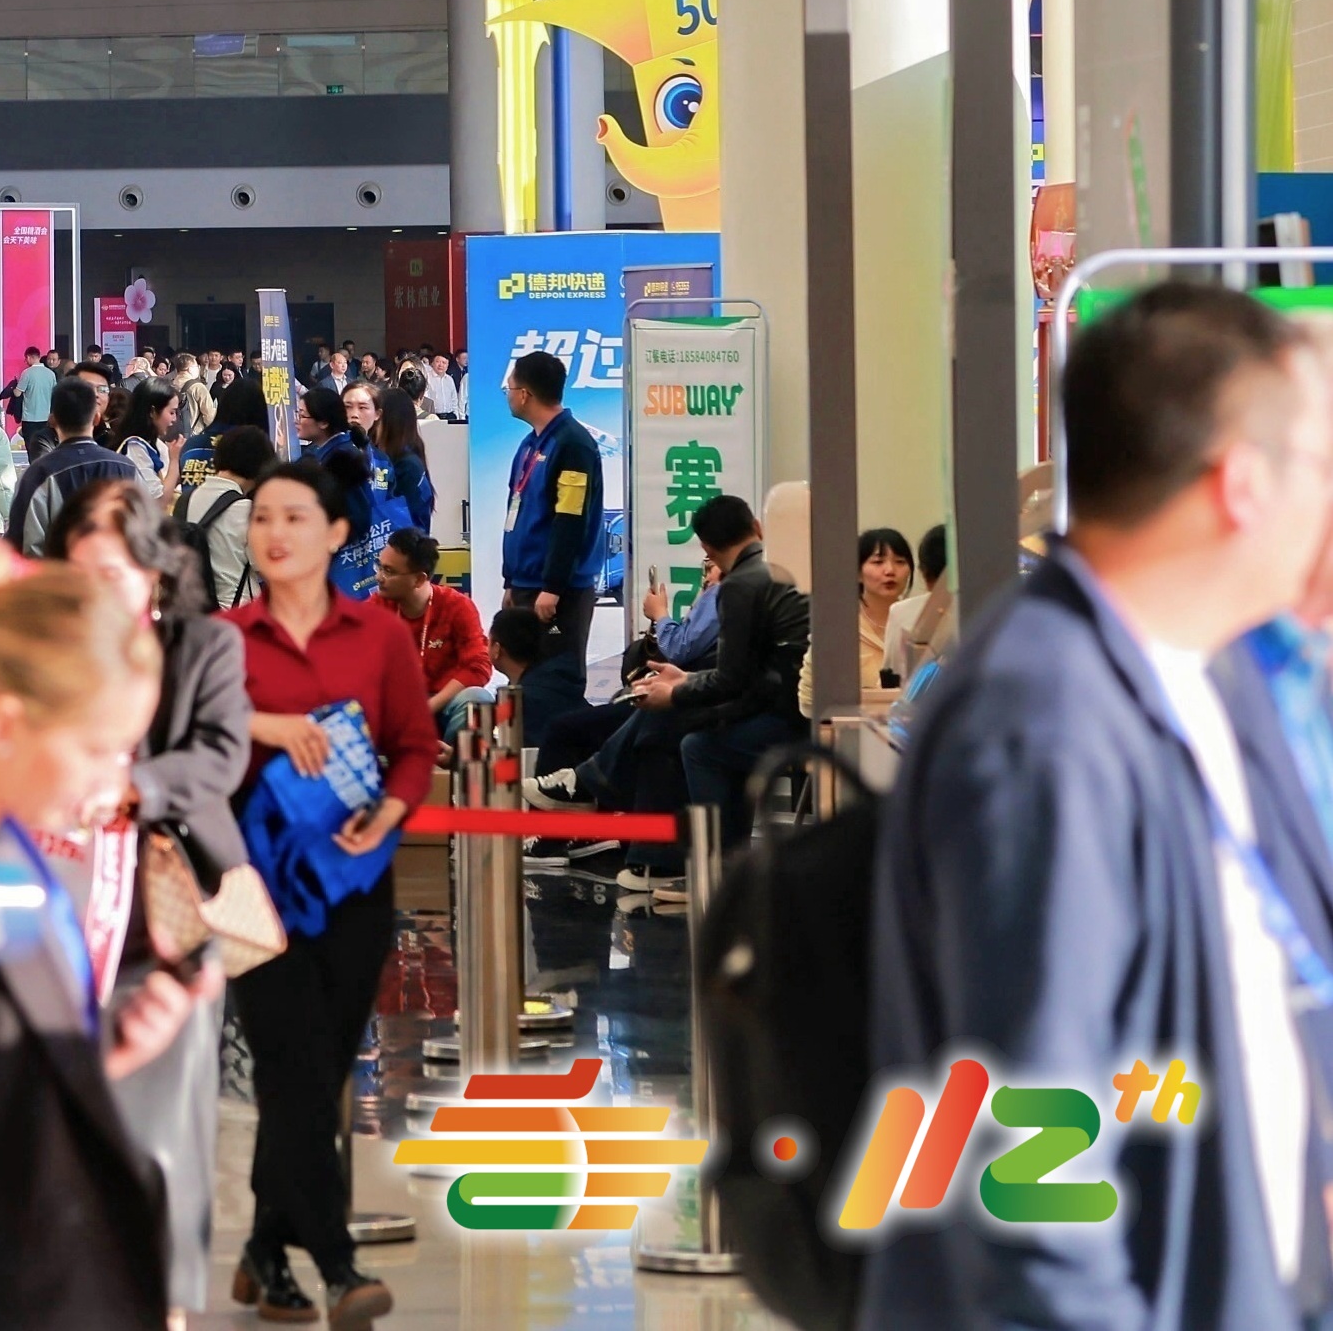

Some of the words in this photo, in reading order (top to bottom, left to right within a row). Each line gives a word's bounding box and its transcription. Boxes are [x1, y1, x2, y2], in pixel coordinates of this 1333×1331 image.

[13, 226, 48, 236] 全国糖酒会
[3, 236, 38, 245] 会天下美味
[527, 272, 606, 292] 德邦快递
[528, 291, 566, 299] DEPPON
[566, 291, 606, 299] EXPRESS
[644, 383, 745, 417] SUBWAY
